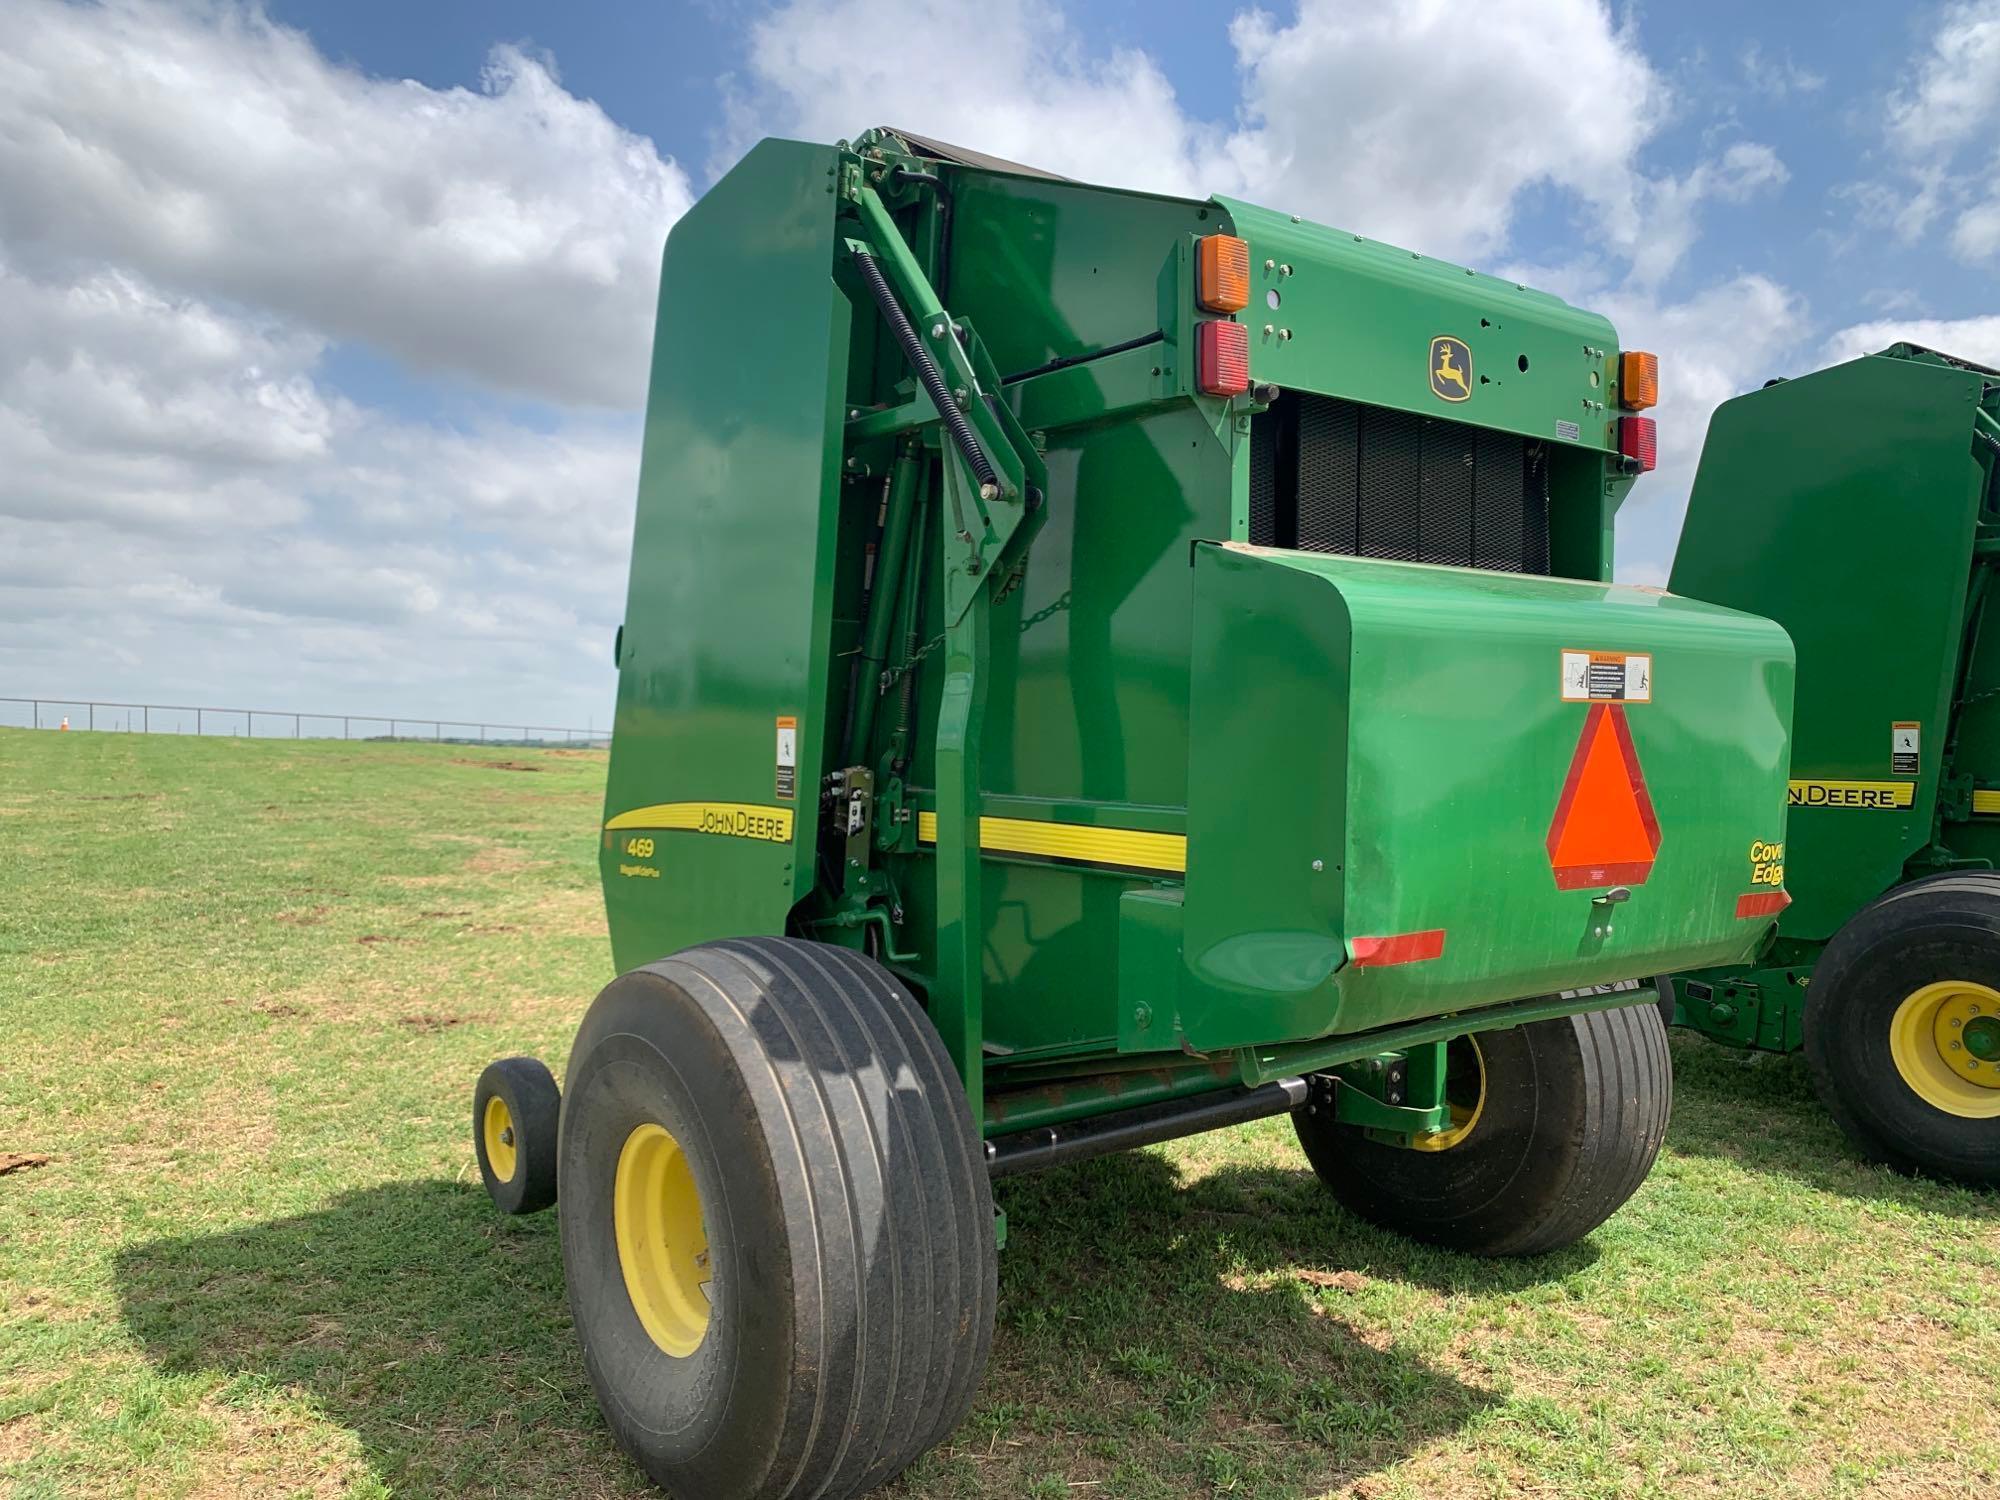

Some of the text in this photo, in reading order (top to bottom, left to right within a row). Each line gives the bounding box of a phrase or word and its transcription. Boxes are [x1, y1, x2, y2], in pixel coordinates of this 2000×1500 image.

[1808, 785, 1895, 805] DEERE
[699, 808, 784, 838] JOHN DEERE
[627, 838, 655, 858] 469
